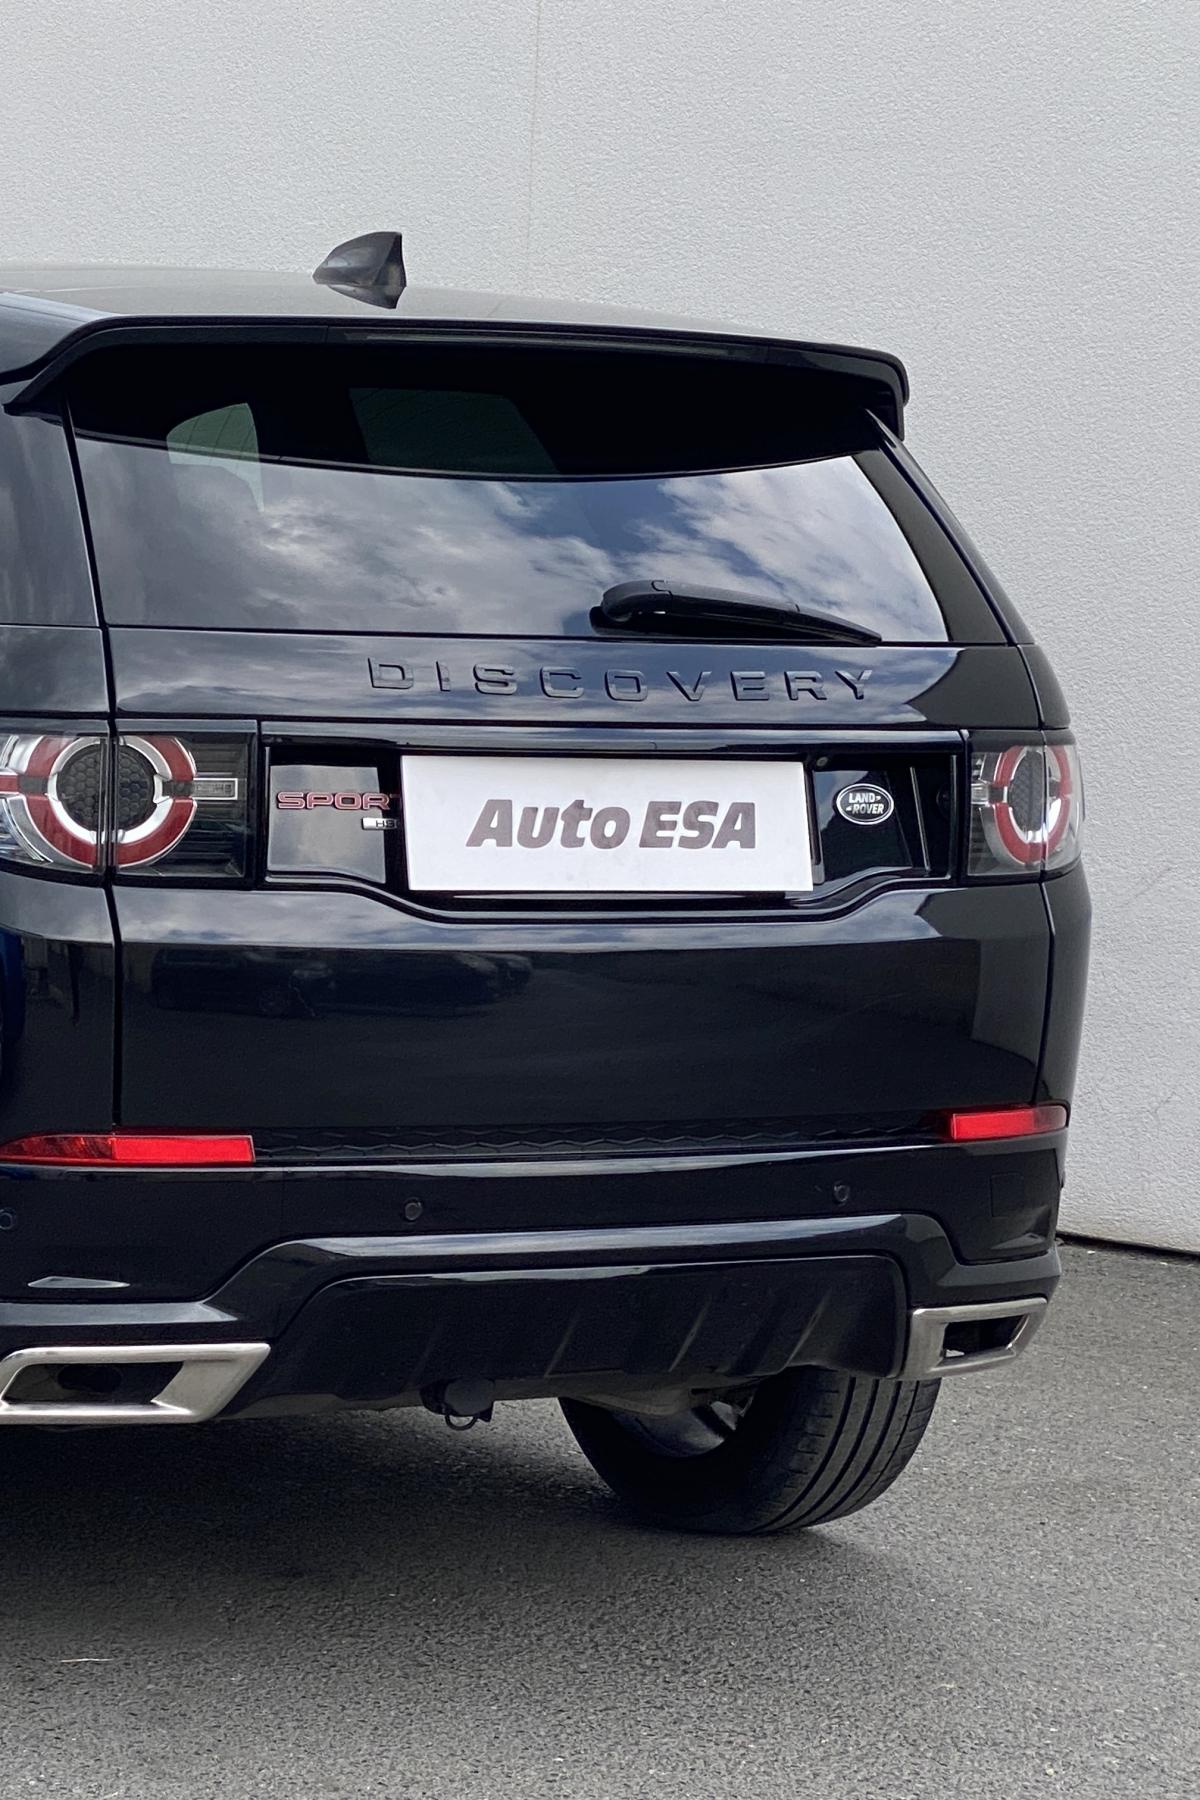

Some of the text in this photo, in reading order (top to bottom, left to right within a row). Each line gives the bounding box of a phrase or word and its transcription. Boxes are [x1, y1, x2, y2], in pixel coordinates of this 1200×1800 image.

[367, 656, 873, 702] DISCOVERY
[848, 792, 876, 804] LAND
[851, 803, 885, 815] ROVER
[464, 798, 756, 850] Auto ESA
